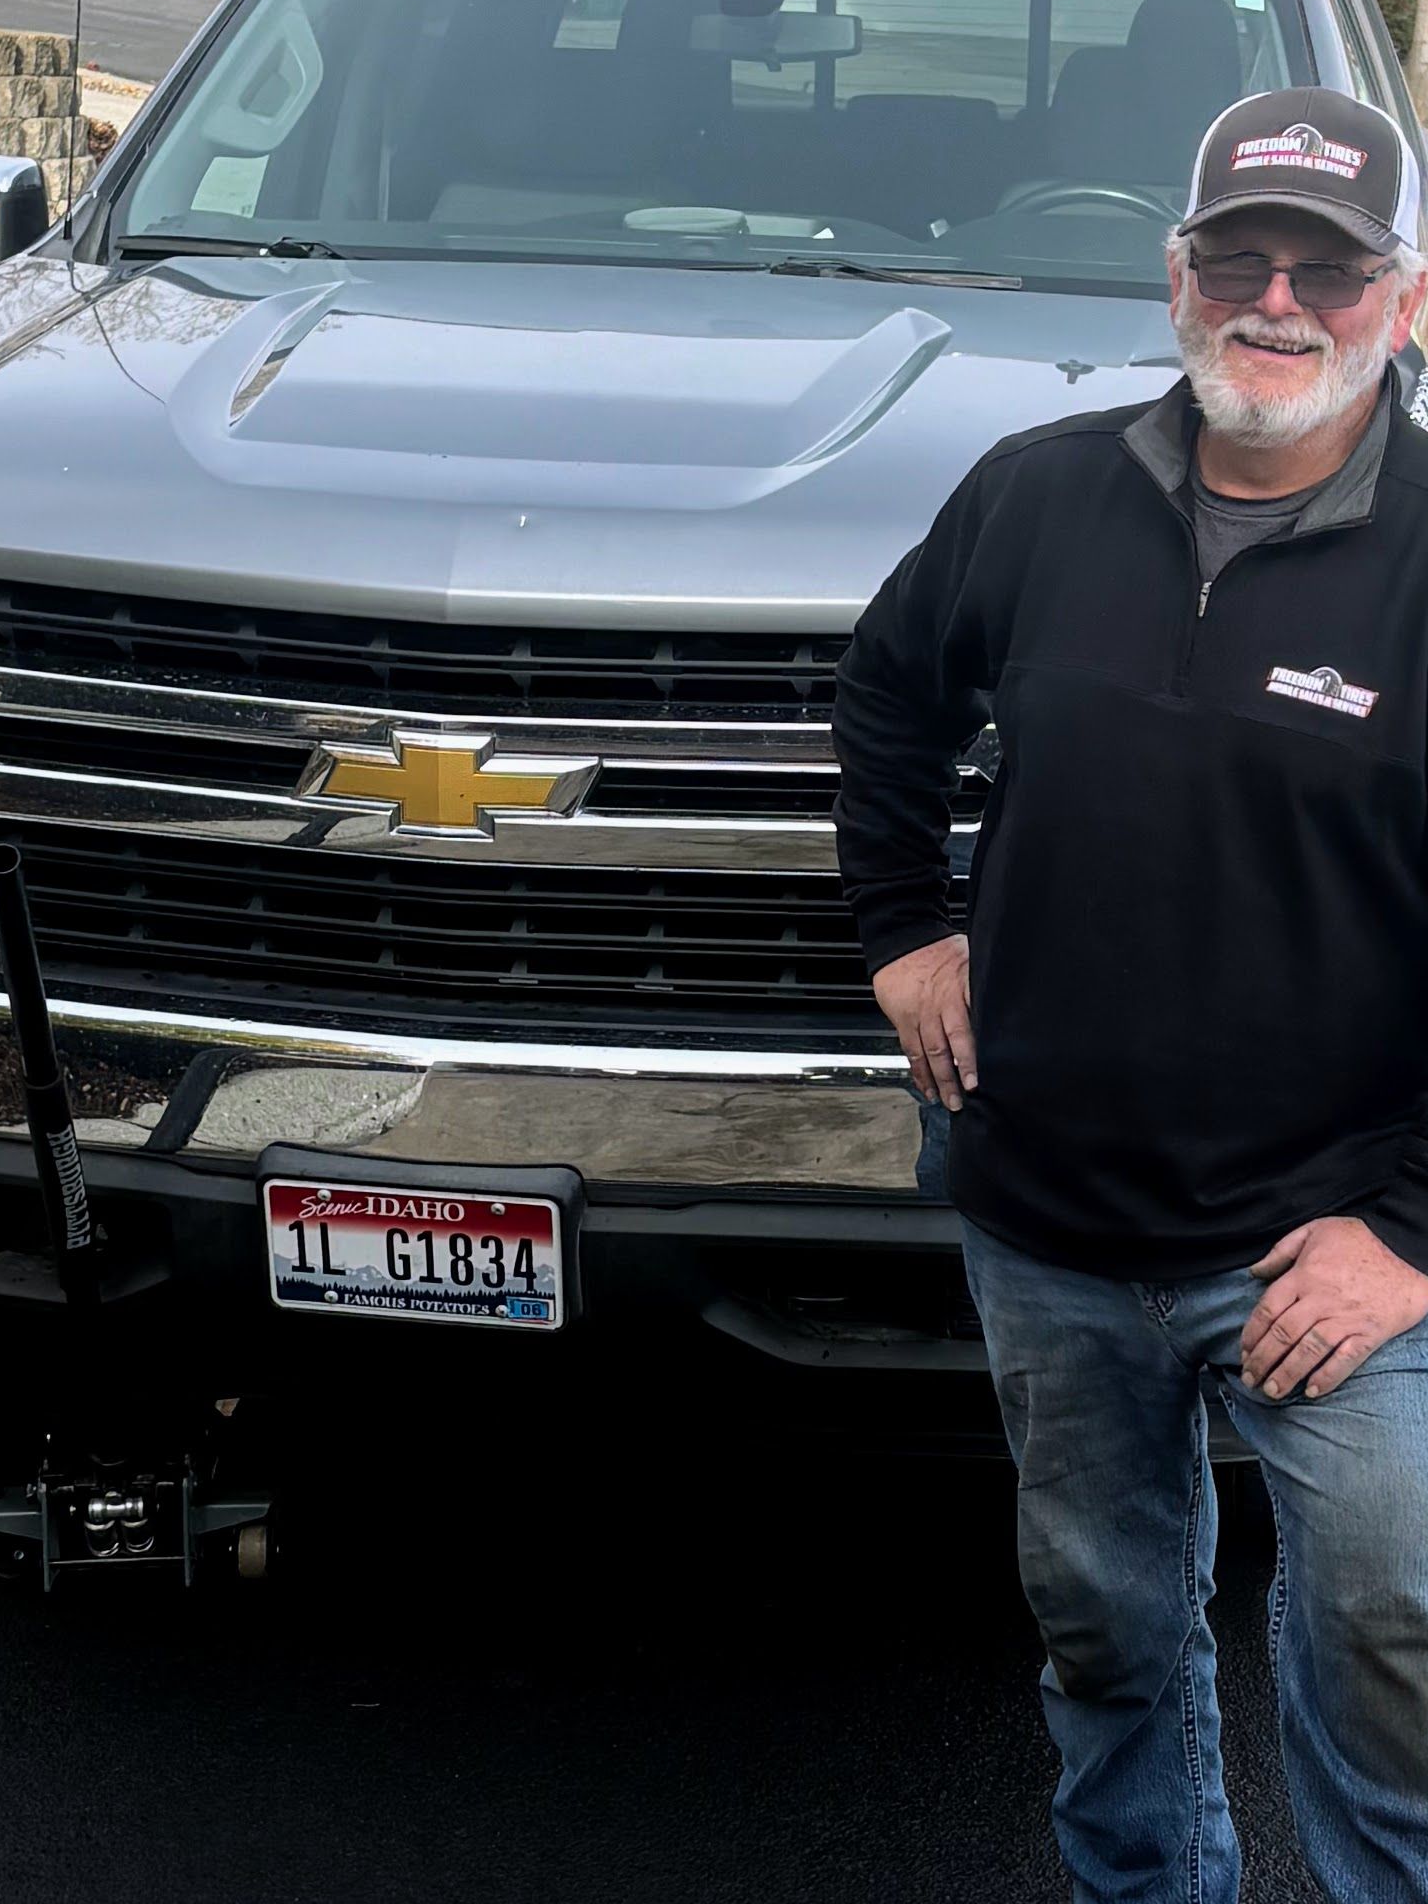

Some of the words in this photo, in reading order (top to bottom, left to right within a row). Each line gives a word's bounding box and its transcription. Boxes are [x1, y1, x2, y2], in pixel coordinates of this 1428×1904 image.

[1236, 137, 1302, 157] FREEDOM
[1324, 142, 1362, 166] TIRES
[46, 1123, 91, 1250] PITTSBURGH
[299, 1196, 367, 1218] Scenic
[365, 1196, 465, 1222] IDAHO
[288, 1219, 347, 1276] 1L
[385, 1227, 538, 1293] G1834
[343, 1293, 406, 1309] FAMOUS
[410, 1300, 490, 1316] POTATOES
